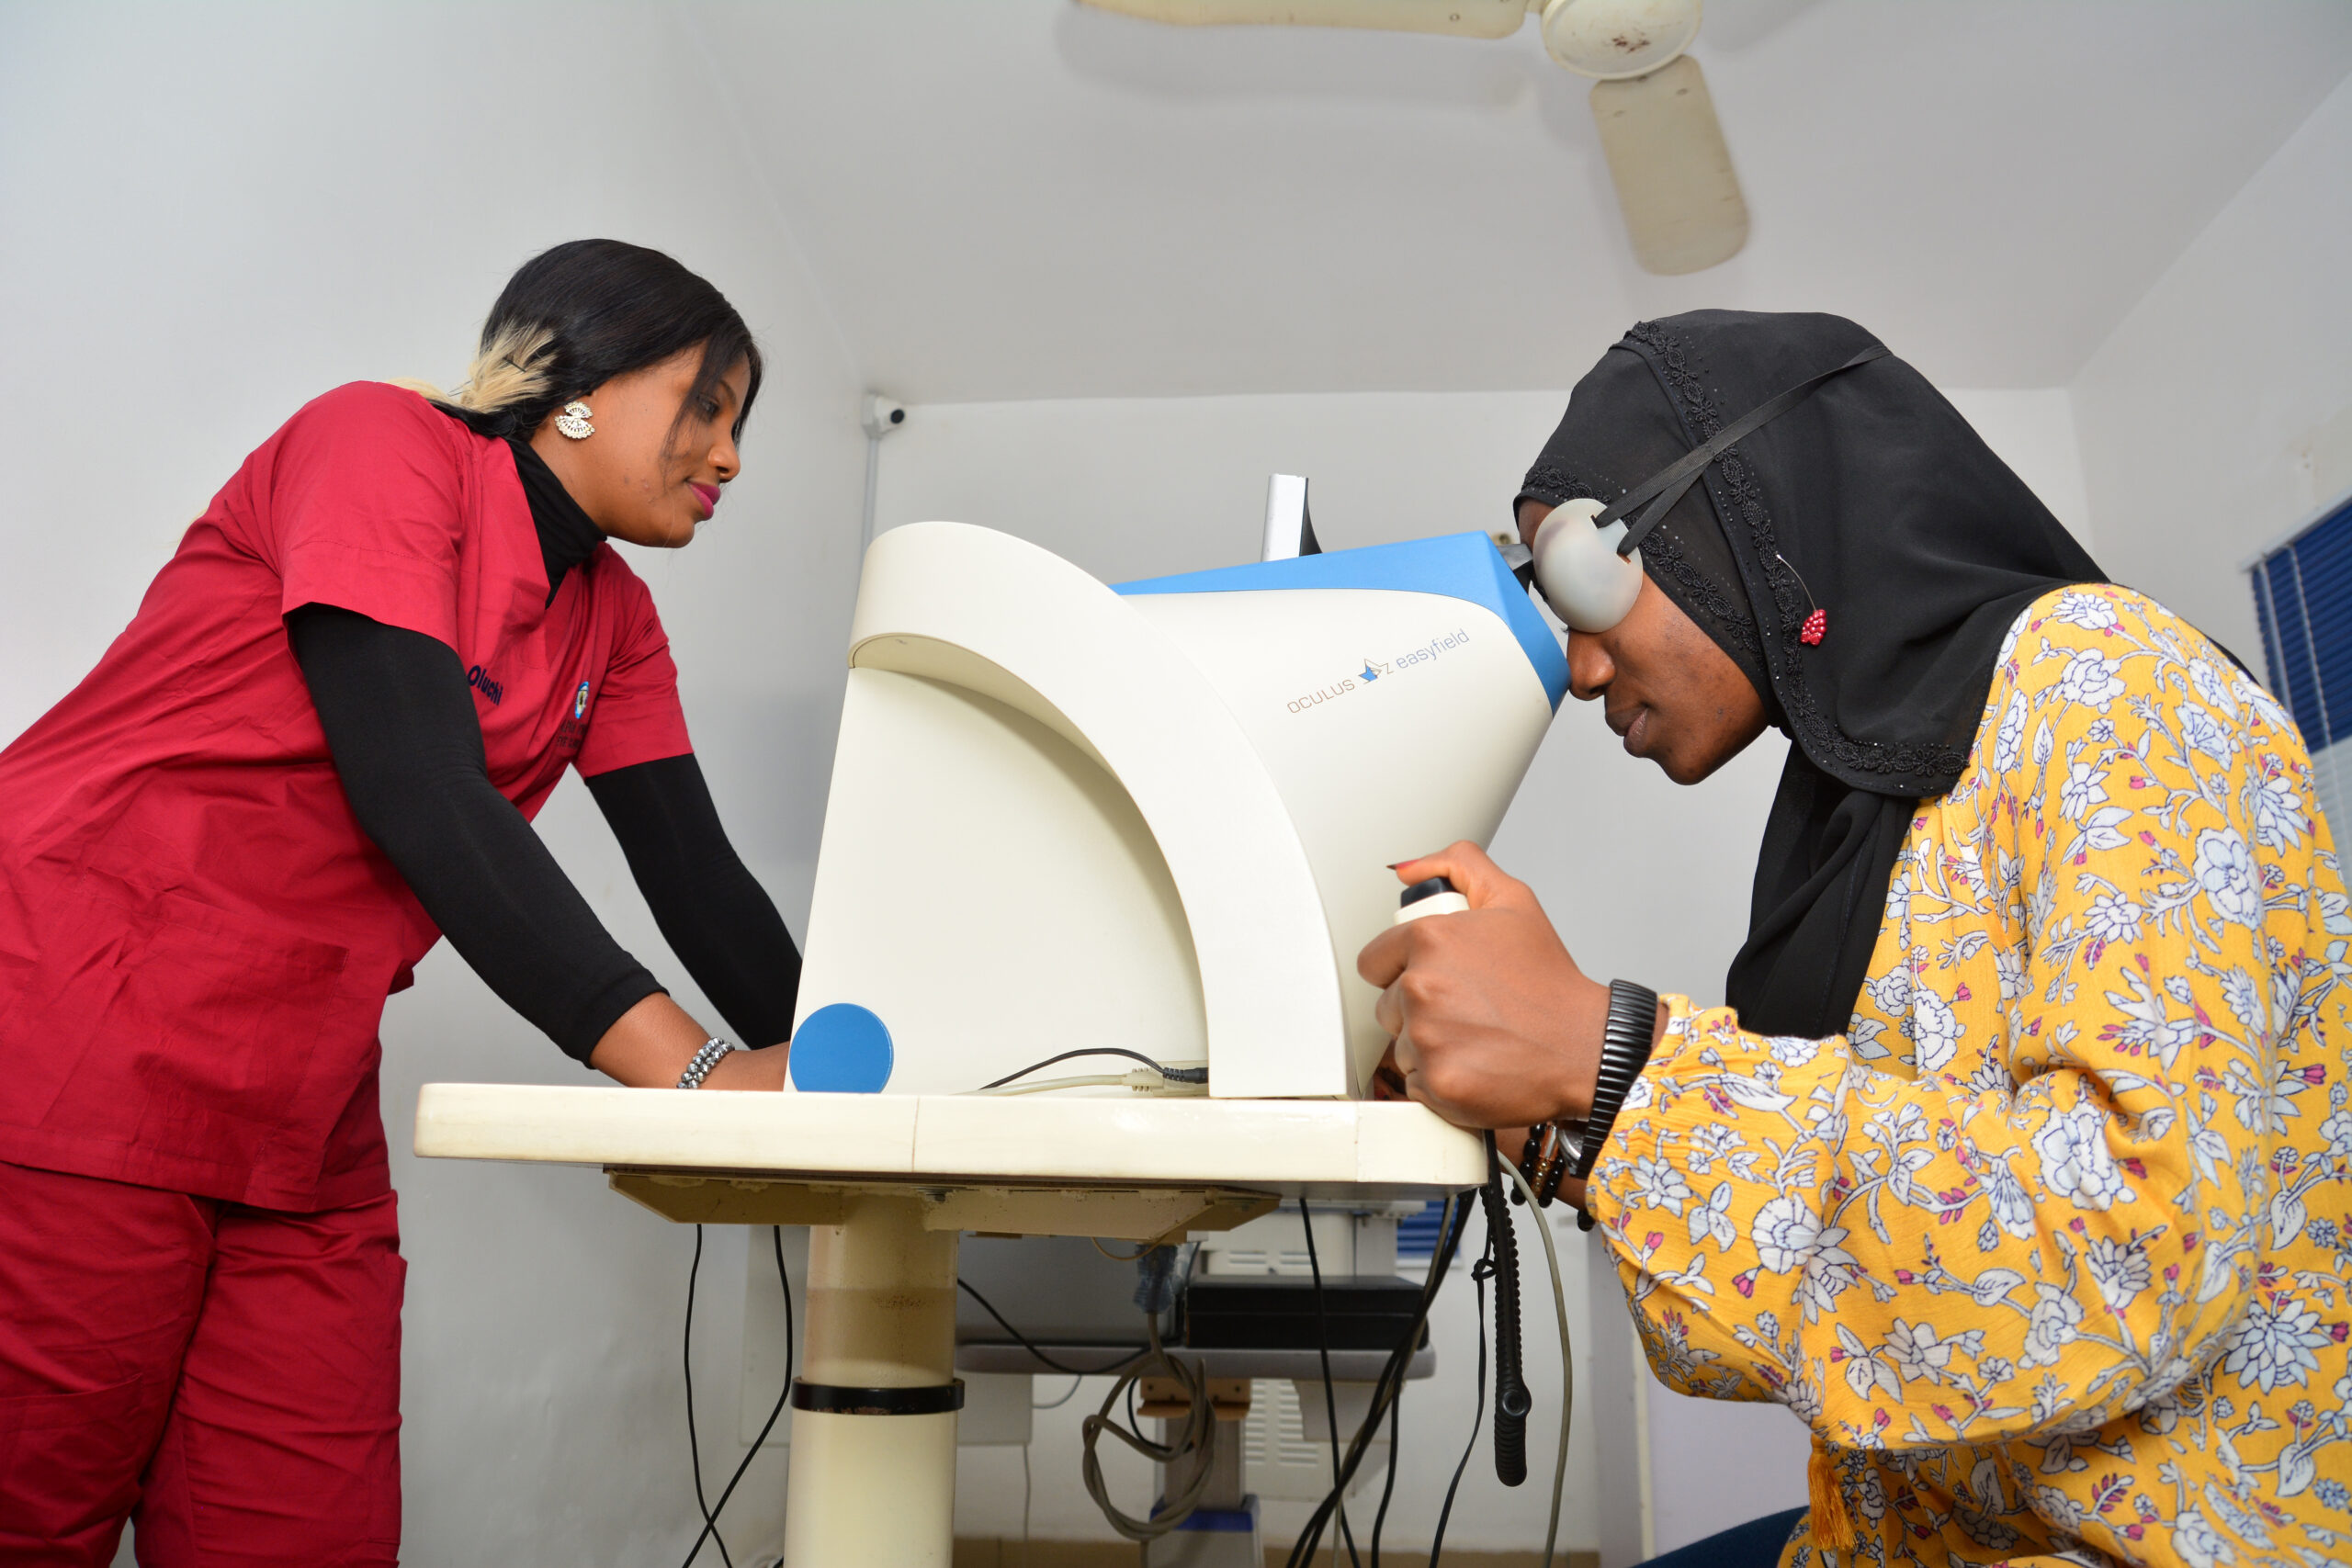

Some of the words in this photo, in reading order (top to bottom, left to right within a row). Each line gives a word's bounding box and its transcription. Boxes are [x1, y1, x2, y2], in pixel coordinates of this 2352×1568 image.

[467, 664, 503, 706] Oluchi
[1286, 678, 1355, 714] OCULUS
[1396, 628, 1470, 669] easyfield
